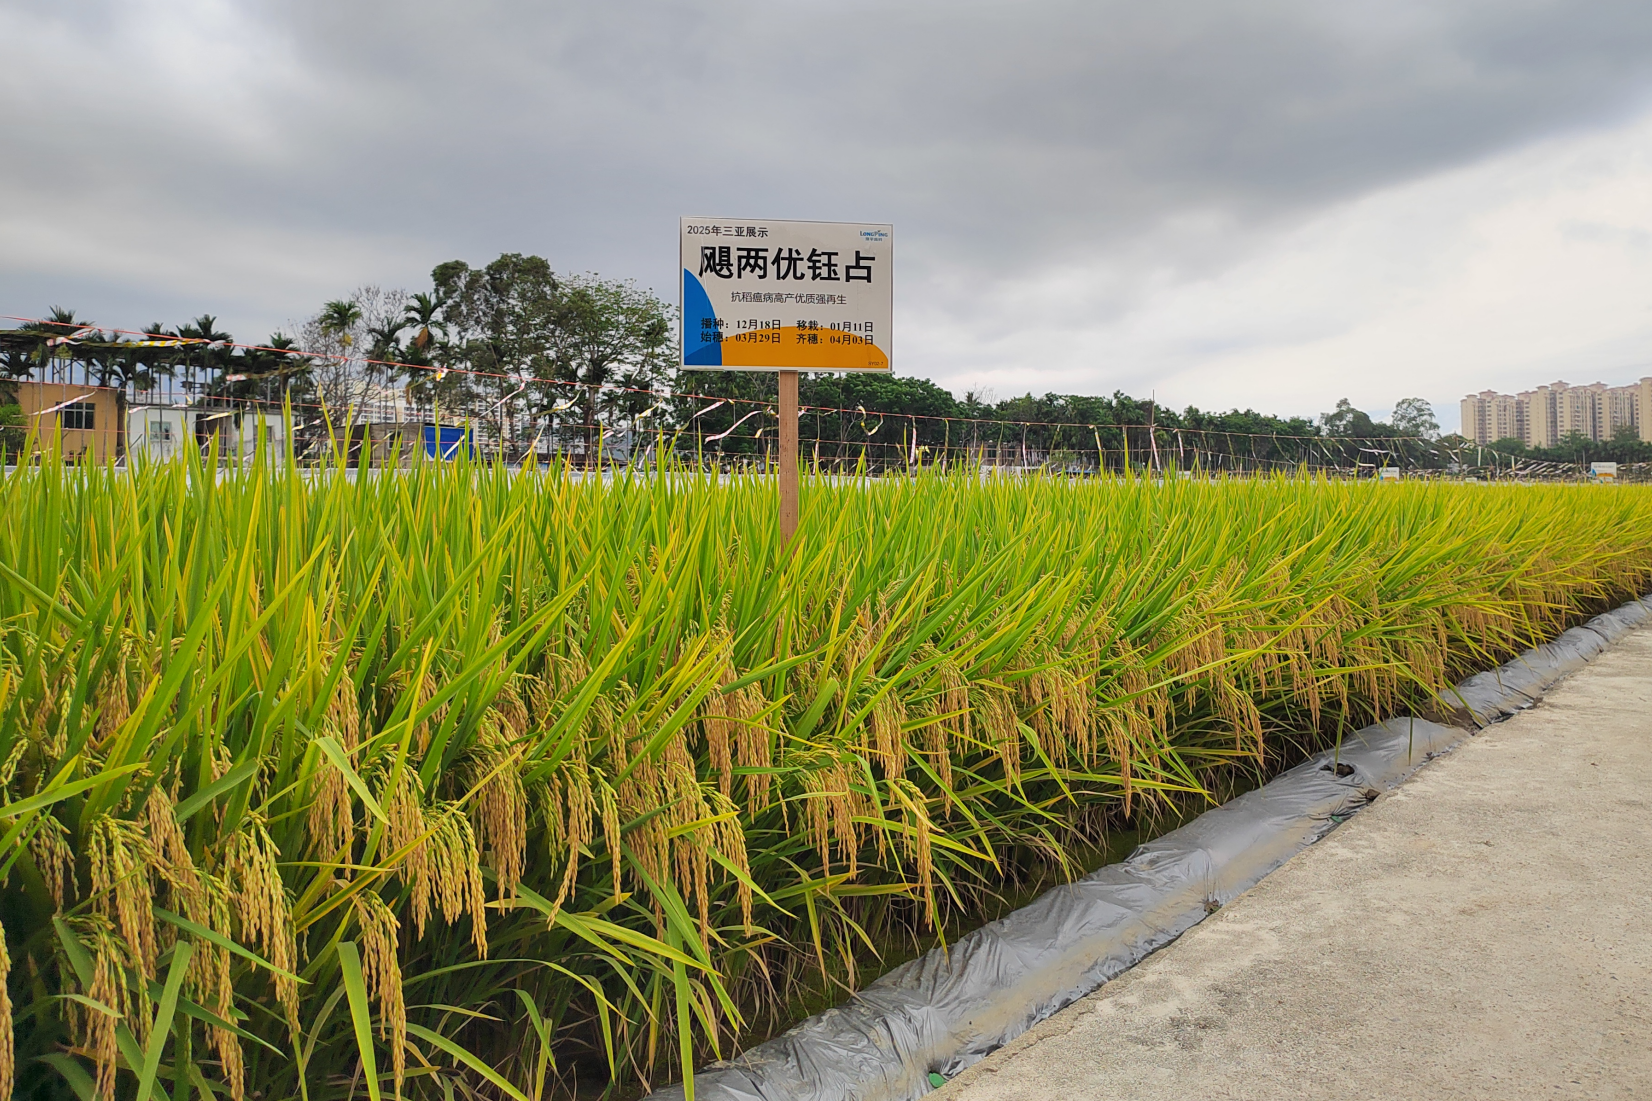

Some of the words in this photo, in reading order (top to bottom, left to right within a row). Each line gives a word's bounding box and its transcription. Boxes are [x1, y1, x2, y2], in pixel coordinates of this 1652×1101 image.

[687, 225, 768, 238] 2025年三亚展示
[698, 246, 875, 283] 飓两优钰占
[731, 291, 847, 305] 抗稻瘟病高产优质强再生
